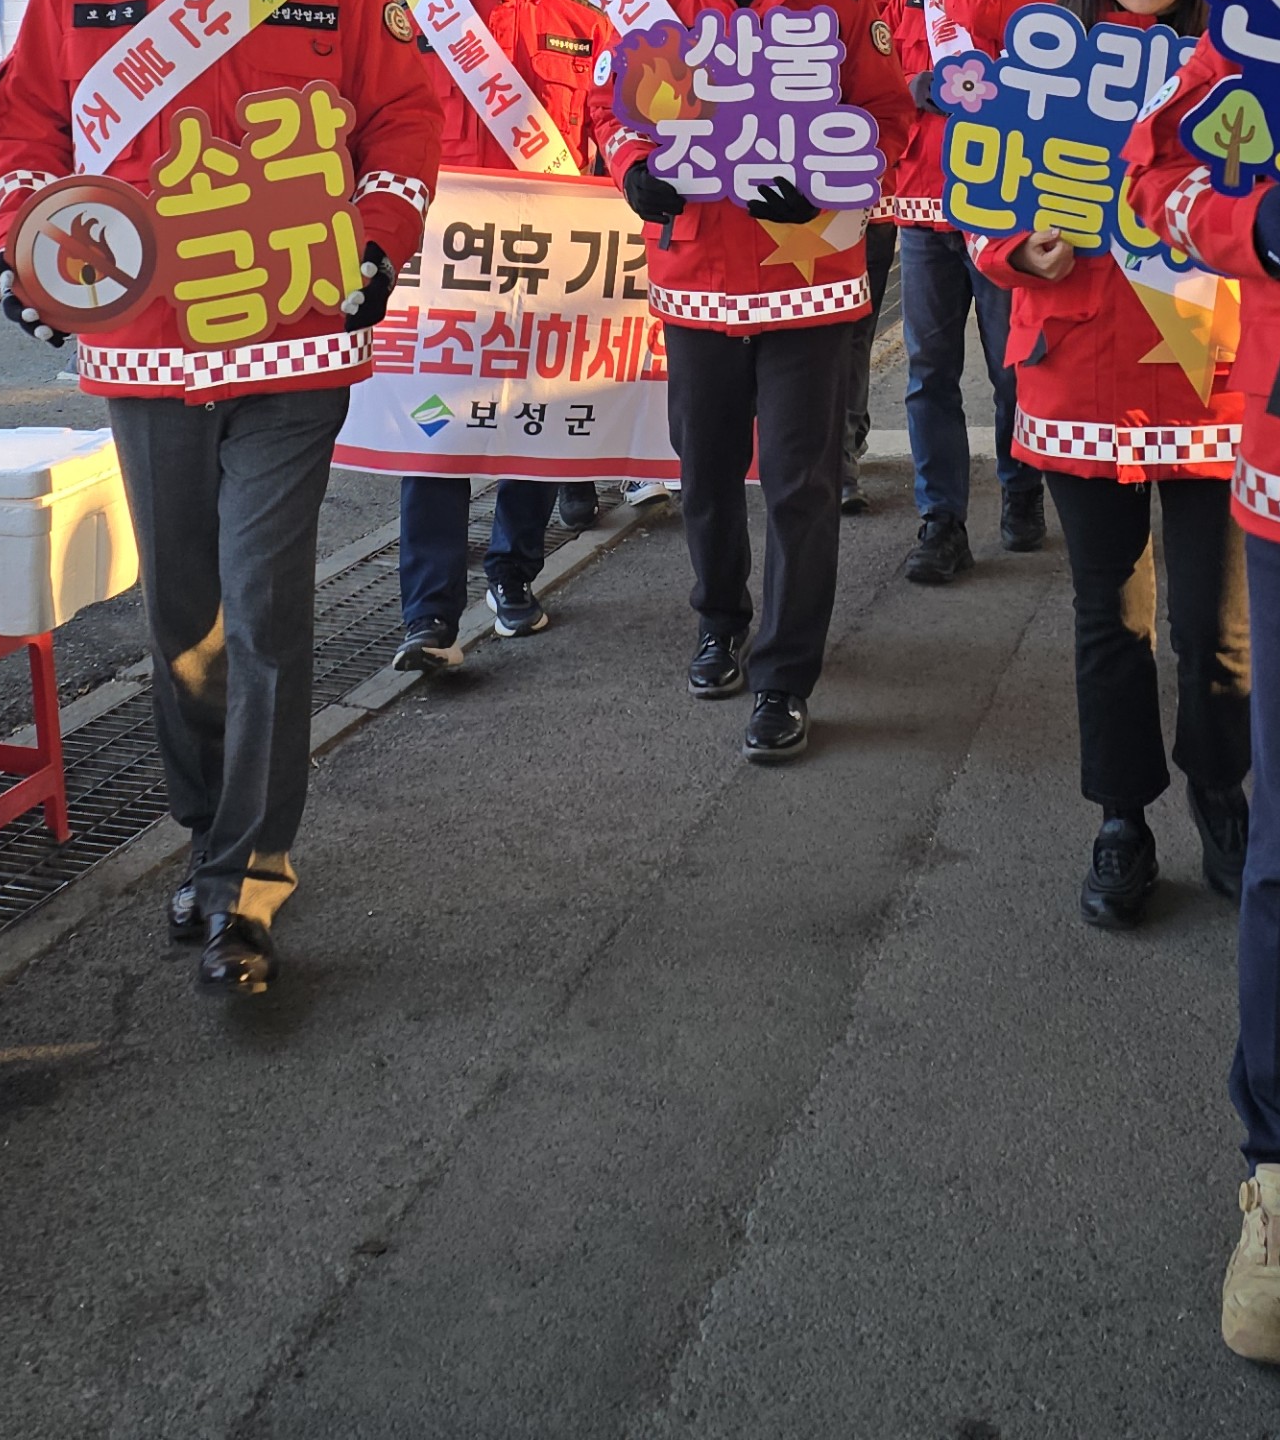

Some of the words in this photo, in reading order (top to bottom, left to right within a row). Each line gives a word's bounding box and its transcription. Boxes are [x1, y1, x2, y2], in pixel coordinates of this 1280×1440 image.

[86, 6, 135, 22] 보성군
[684, 11, 840, 105] 산불
[998, 12, 1196, 122] 우리
[157, 89, 348, 217] 소각
[654, 111, 879, 203] 조심은
[175, 210, 364, 345] 금지
[441, 221, 553, 296] 연휴
[466, 400, 597, 437] 보성군
